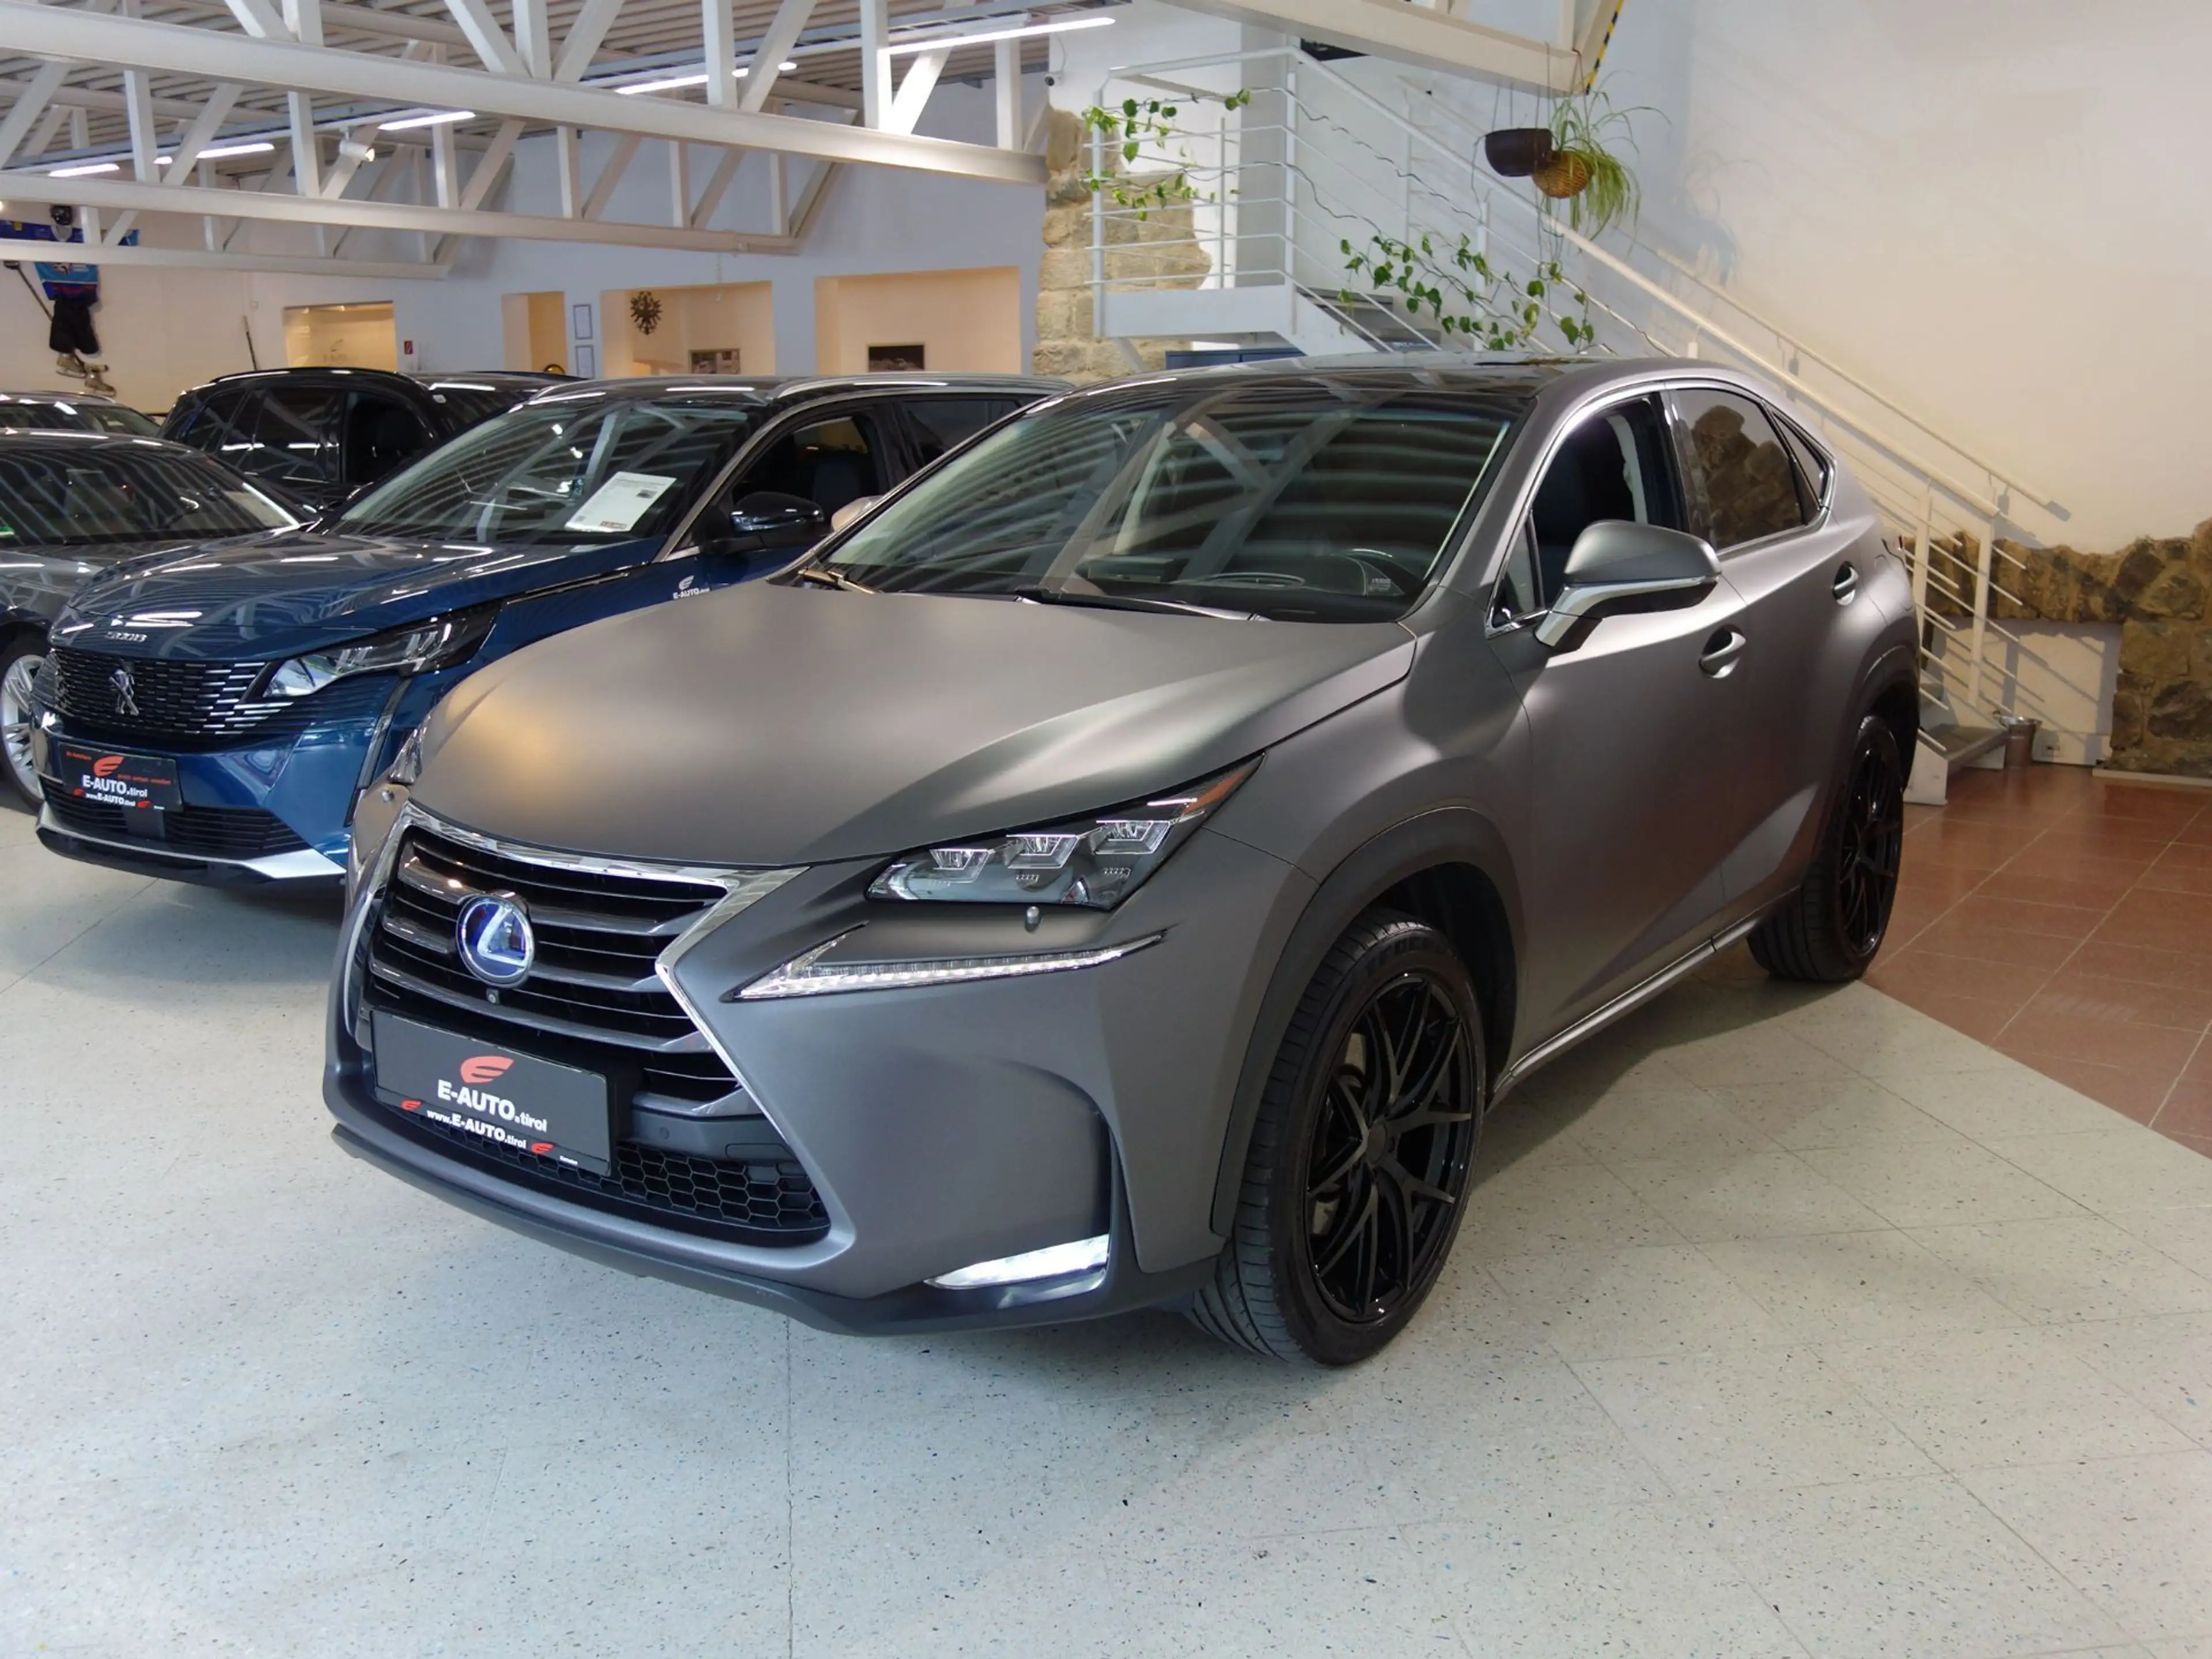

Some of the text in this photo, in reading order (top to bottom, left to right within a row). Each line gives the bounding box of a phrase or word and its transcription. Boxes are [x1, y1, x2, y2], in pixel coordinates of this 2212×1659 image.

[82, 774, 147, 797] E-AUTO.tirol
[438, 1080, 547, 1132] E-AUTO.tirol
[426, 1109, 527, 1149] www.E-AUTO.tirol
